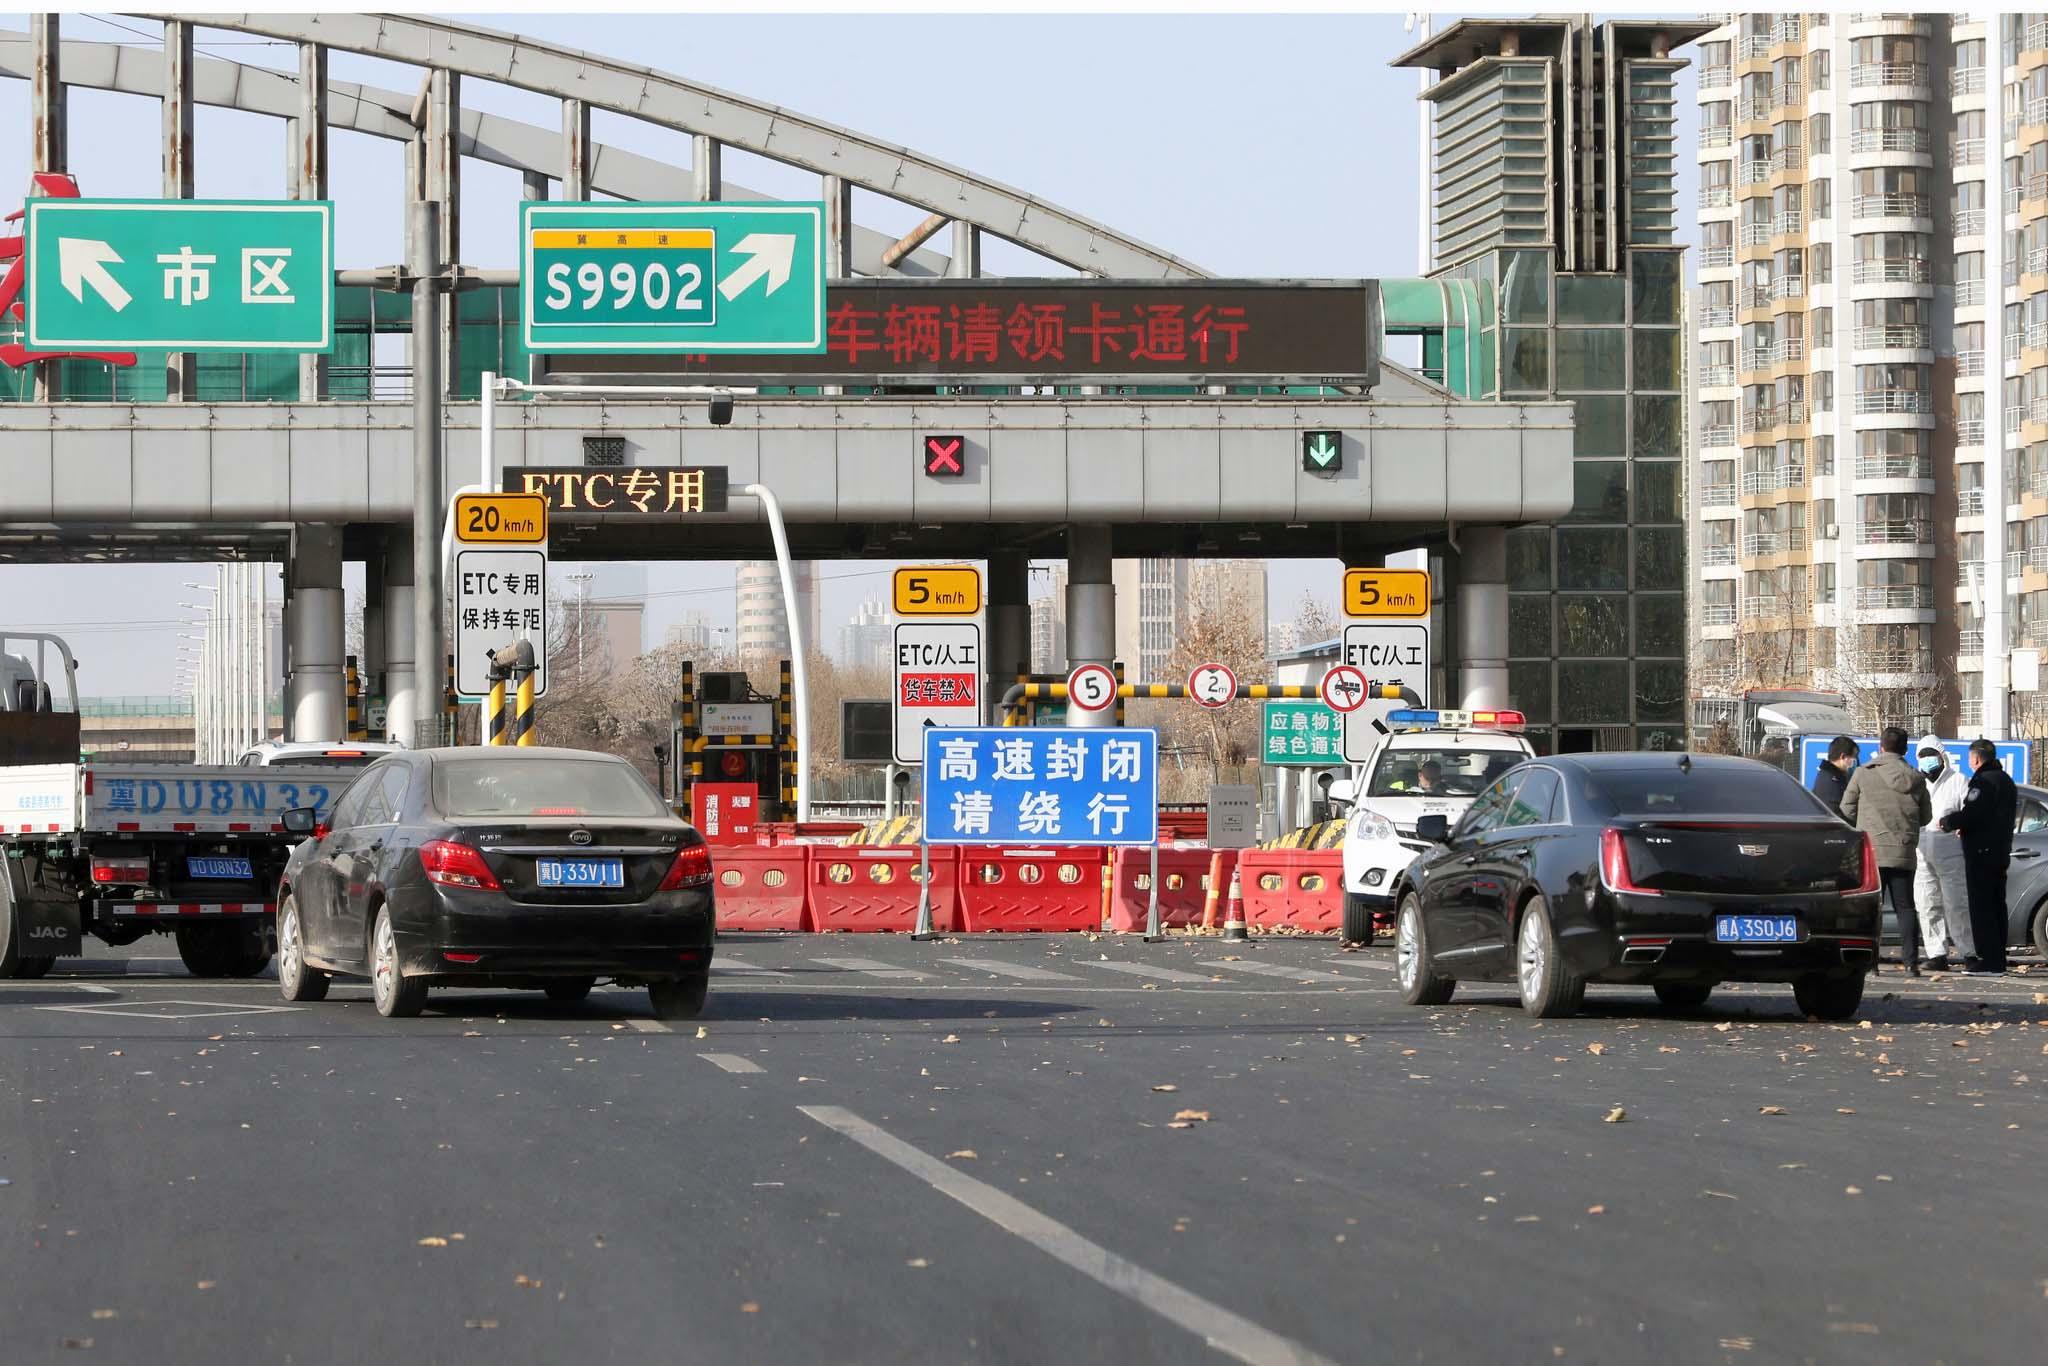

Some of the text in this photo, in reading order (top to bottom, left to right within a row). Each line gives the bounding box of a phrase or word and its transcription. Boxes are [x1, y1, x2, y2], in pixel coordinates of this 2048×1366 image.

[157, 246, 295, 306] 市区
[545, 262, 702, 310] S9902
[827, 301, 1250, 364] 车辆请领卡通行
[522, 468, 705, 513] ETC专用
[468, 506, 534, 533] 20 km/h
[909, 578, 965, 604] 5 km/h
[1359, 580, 1415, 606] 5 km/h
[463, 608, 541, 631] 保持车距
[899, 644, 976, 666] ETC/人工
[1347, 644, 1422, 666] ETC/人工
[904, 678, 972, 703] 货车禁入
[1085, 677, 1100, 699] 5
[939, 737, 1141, 783] 高速封闭
[951, 791, 1130, 836] 请绕行
[29, 926, 68, 938] JAC
[253, 926, 277, 937] JA
